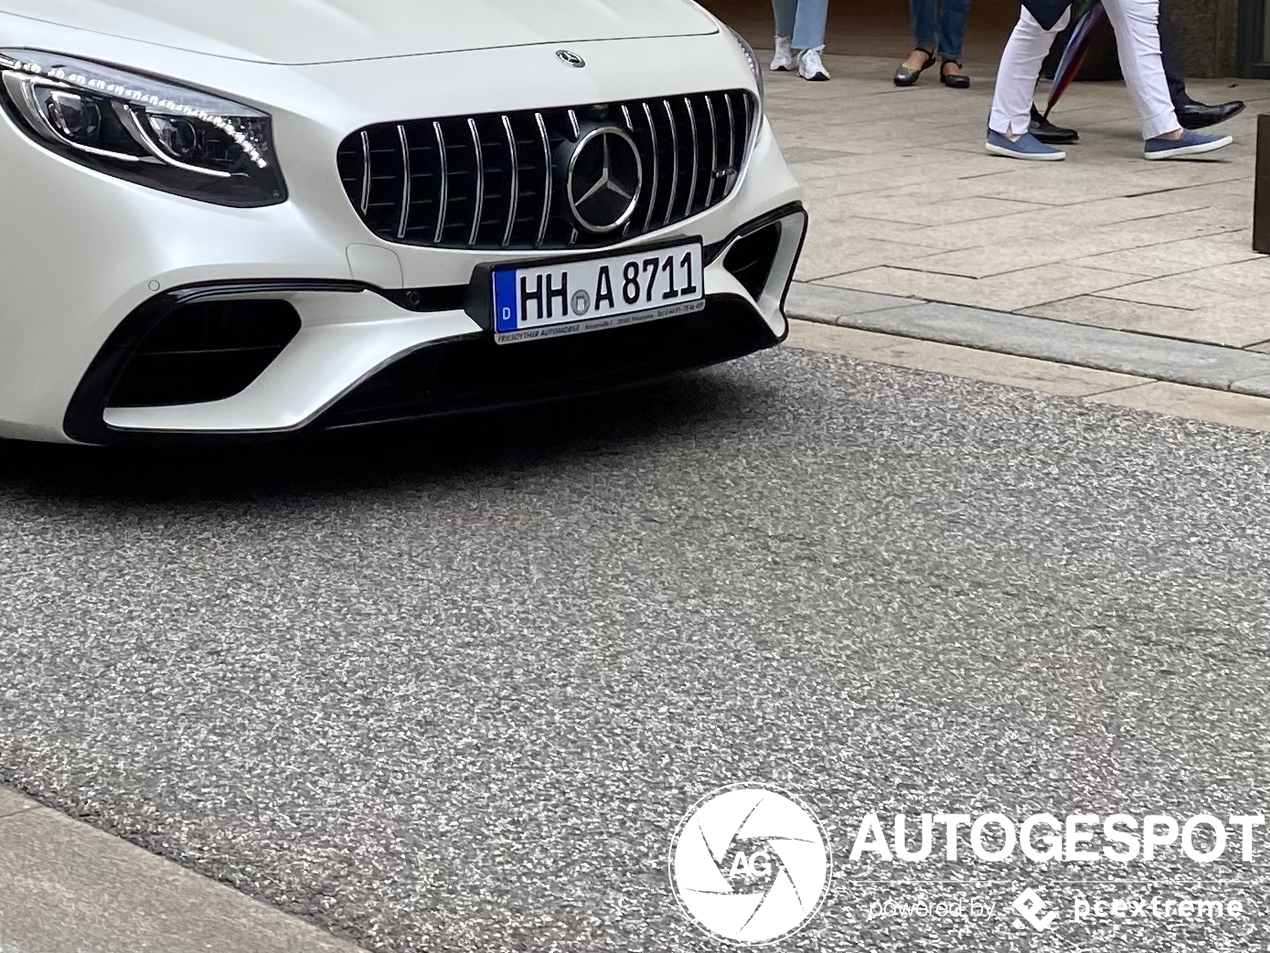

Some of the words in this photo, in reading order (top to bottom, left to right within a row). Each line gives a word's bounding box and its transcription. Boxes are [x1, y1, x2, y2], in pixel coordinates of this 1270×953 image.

[519, 272, 569, 321] HH
[594, 265, 615, 311] A
[622, 251, 697, 305] 8711
[502, 307, 512, 320] D
